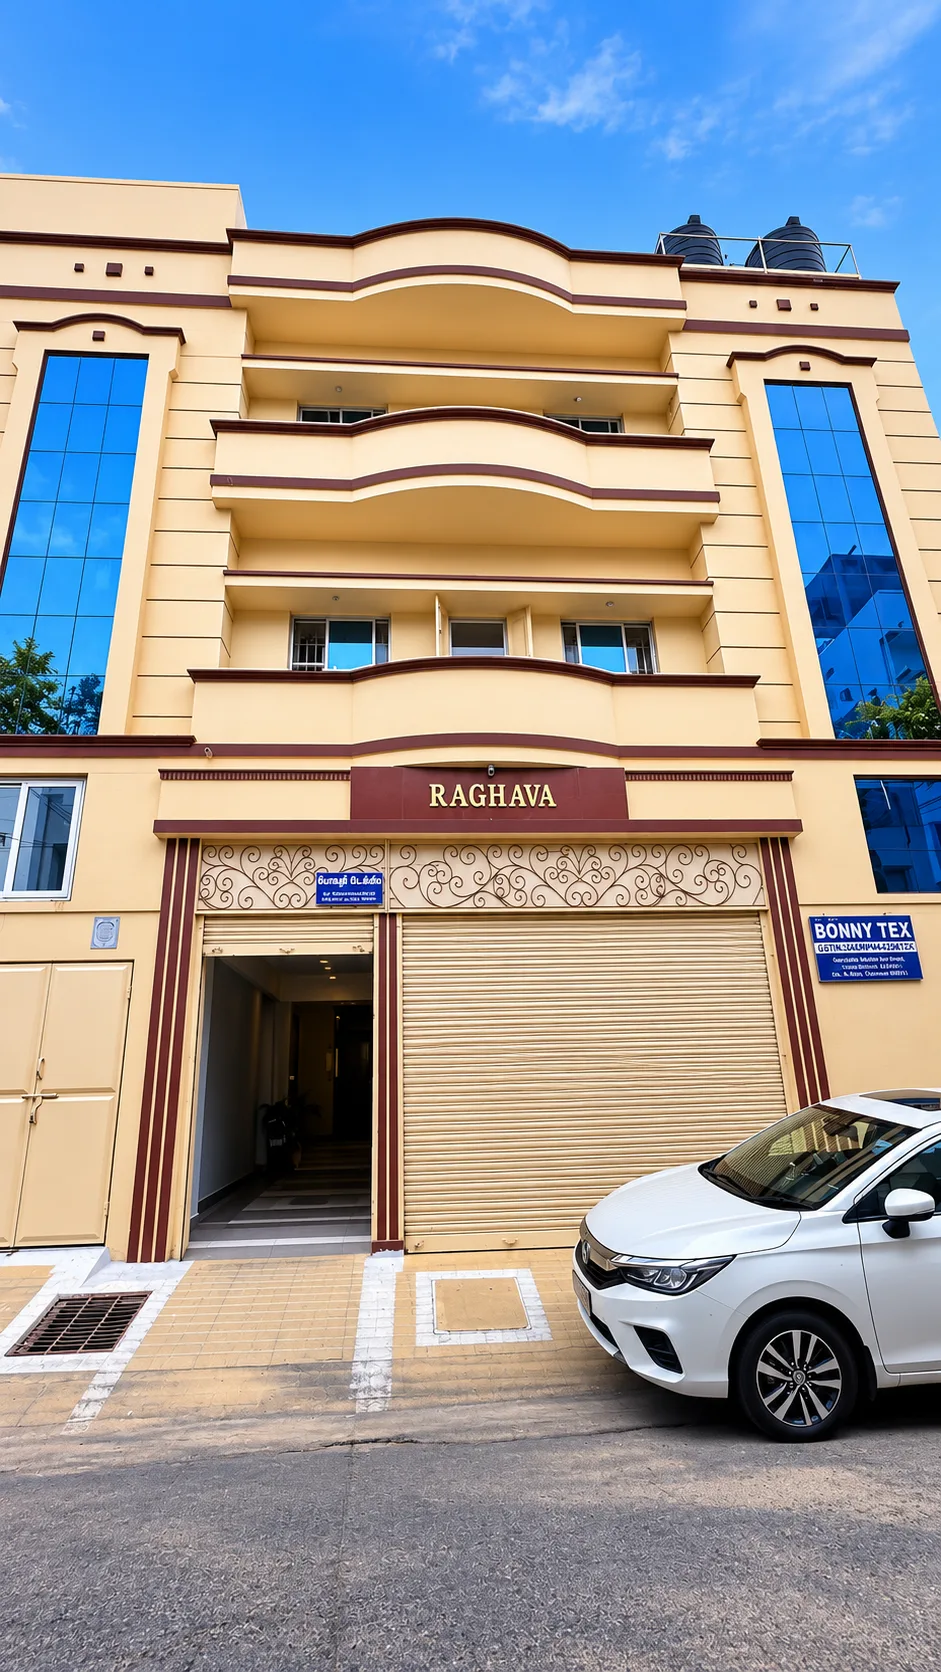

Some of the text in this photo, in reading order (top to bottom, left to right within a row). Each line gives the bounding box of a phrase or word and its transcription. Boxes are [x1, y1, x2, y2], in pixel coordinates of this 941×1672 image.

[429, 783, 557, 808] RAGHAVA
[814, 922, 912, 939] BONNY TEX
